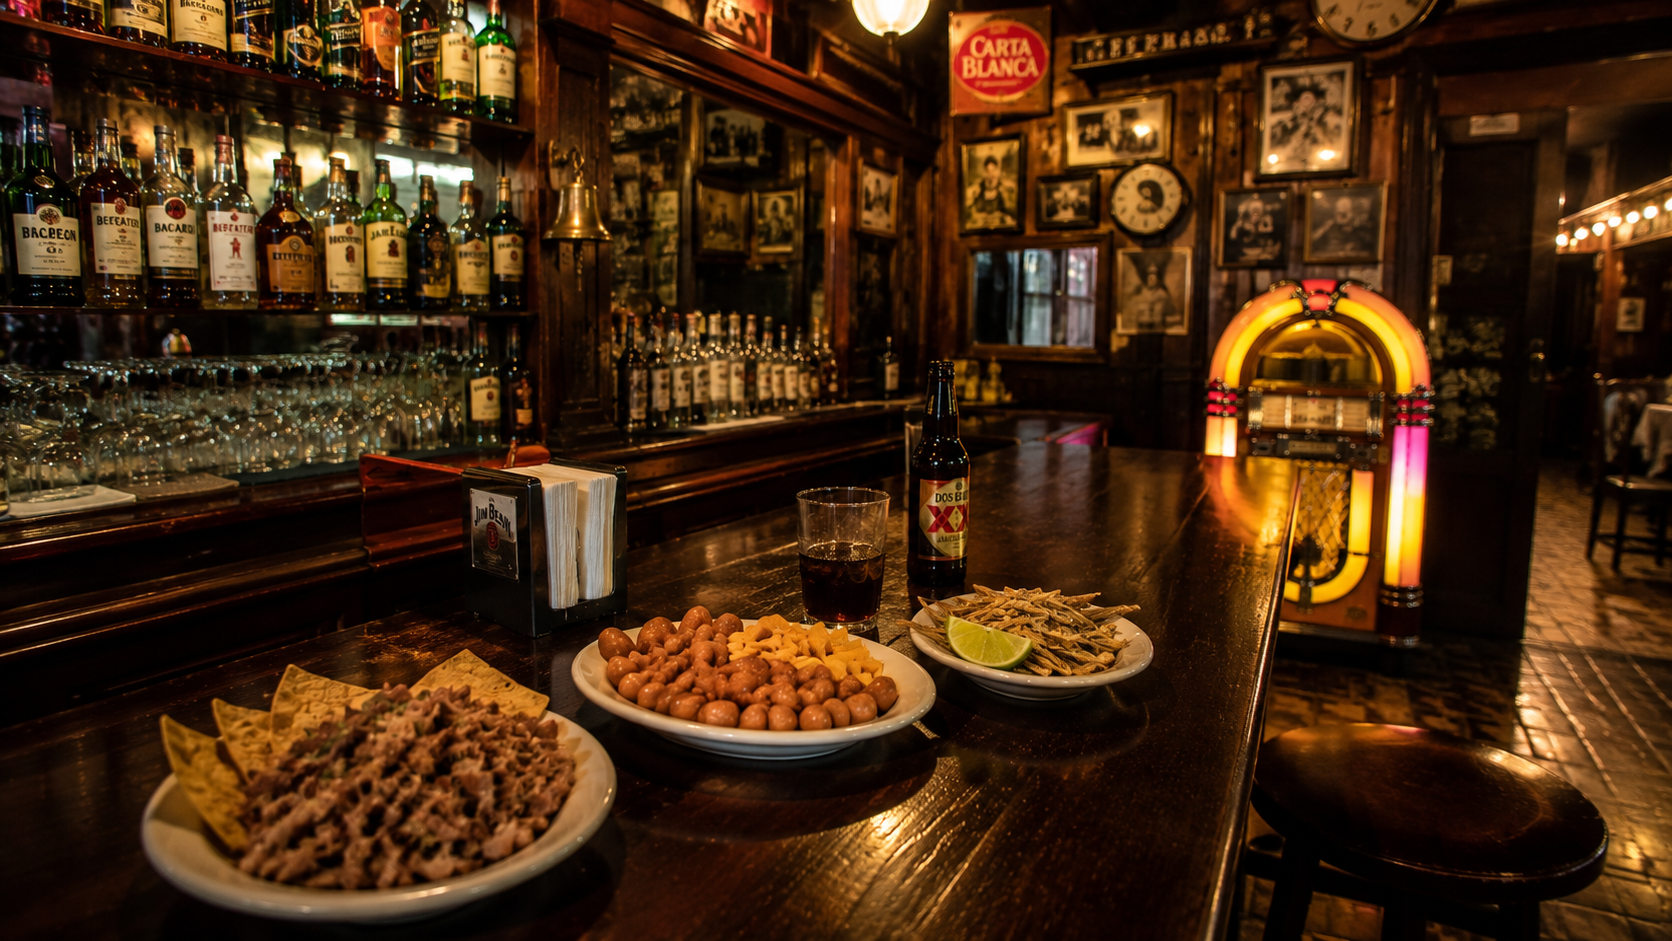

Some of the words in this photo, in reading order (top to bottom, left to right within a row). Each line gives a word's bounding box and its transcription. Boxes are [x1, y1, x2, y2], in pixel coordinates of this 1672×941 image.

[970, 35, 1032, 58] CARTA
[962, 55, 1039, 79] BLANCA
[935, 493, 953, 503] DOS
[474, 506, 487, 526] JIM
